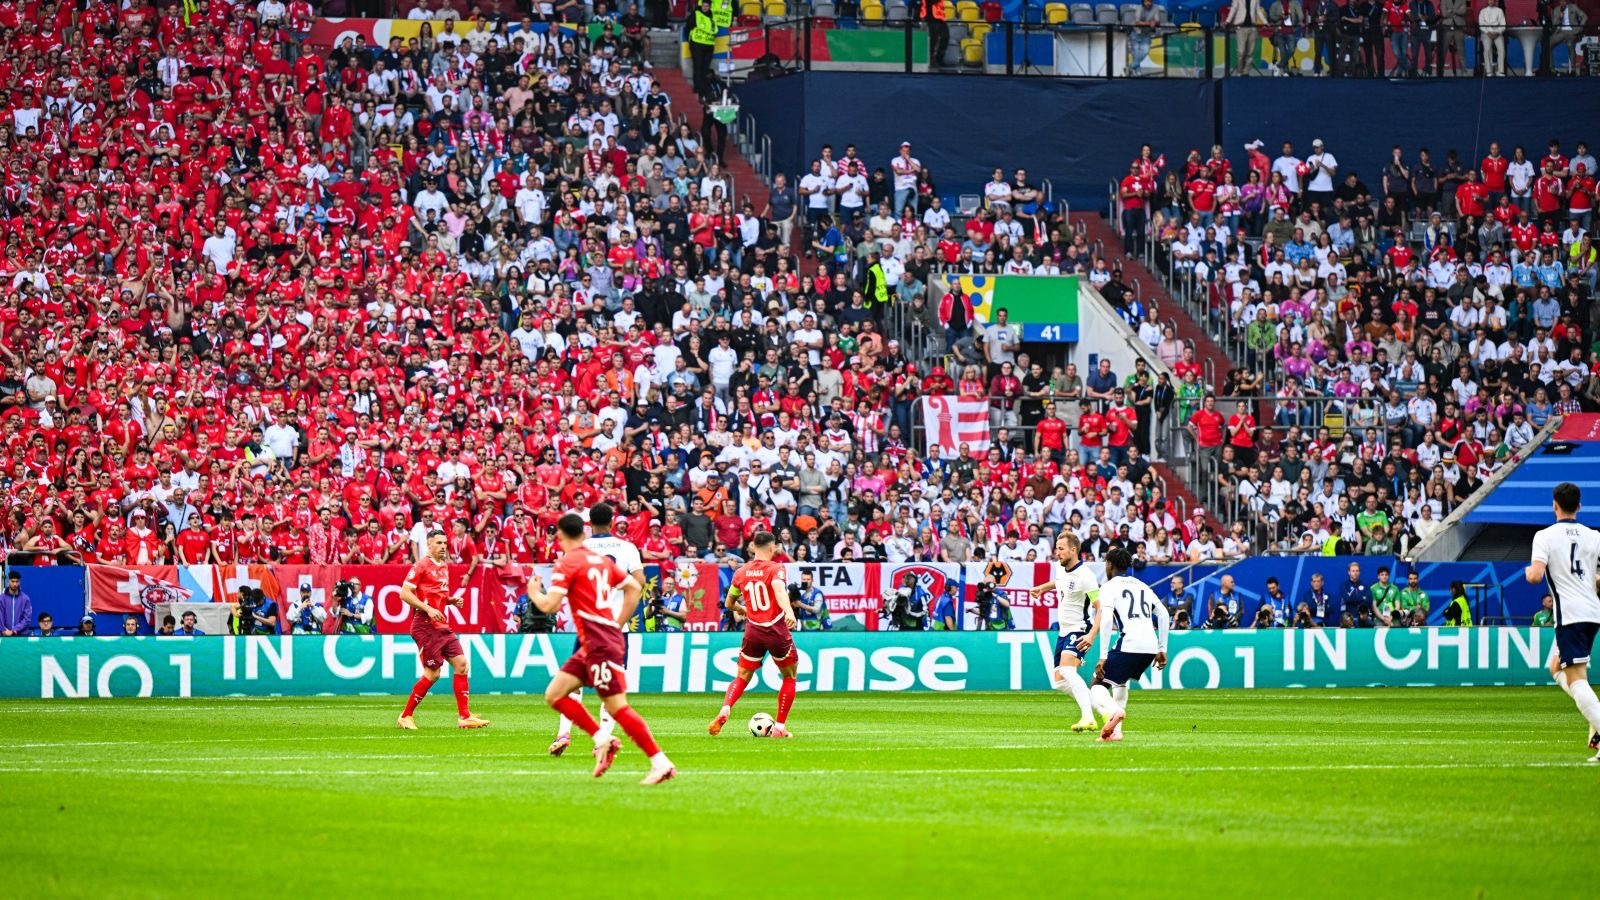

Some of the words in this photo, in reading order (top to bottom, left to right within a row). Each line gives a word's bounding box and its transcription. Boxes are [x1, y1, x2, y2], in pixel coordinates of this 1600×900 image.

[1040, 325, 1061, 341] 41
[1565, 528, 1580, 536] RICE
[1570, 542, 1585, 580] 4
[744, 581, 771, 612] 10
[1122, 589, 1151, 619] 26
[1069, 634, 1077, 645] 9
[1283, 628, 1347, 671] IN
[1374, 626, 1592, 671] CHIN
[223, 635, 293, 680] IN
[627, 632, 969, 692] Hisense
[590, 661, 612, 686] 26
